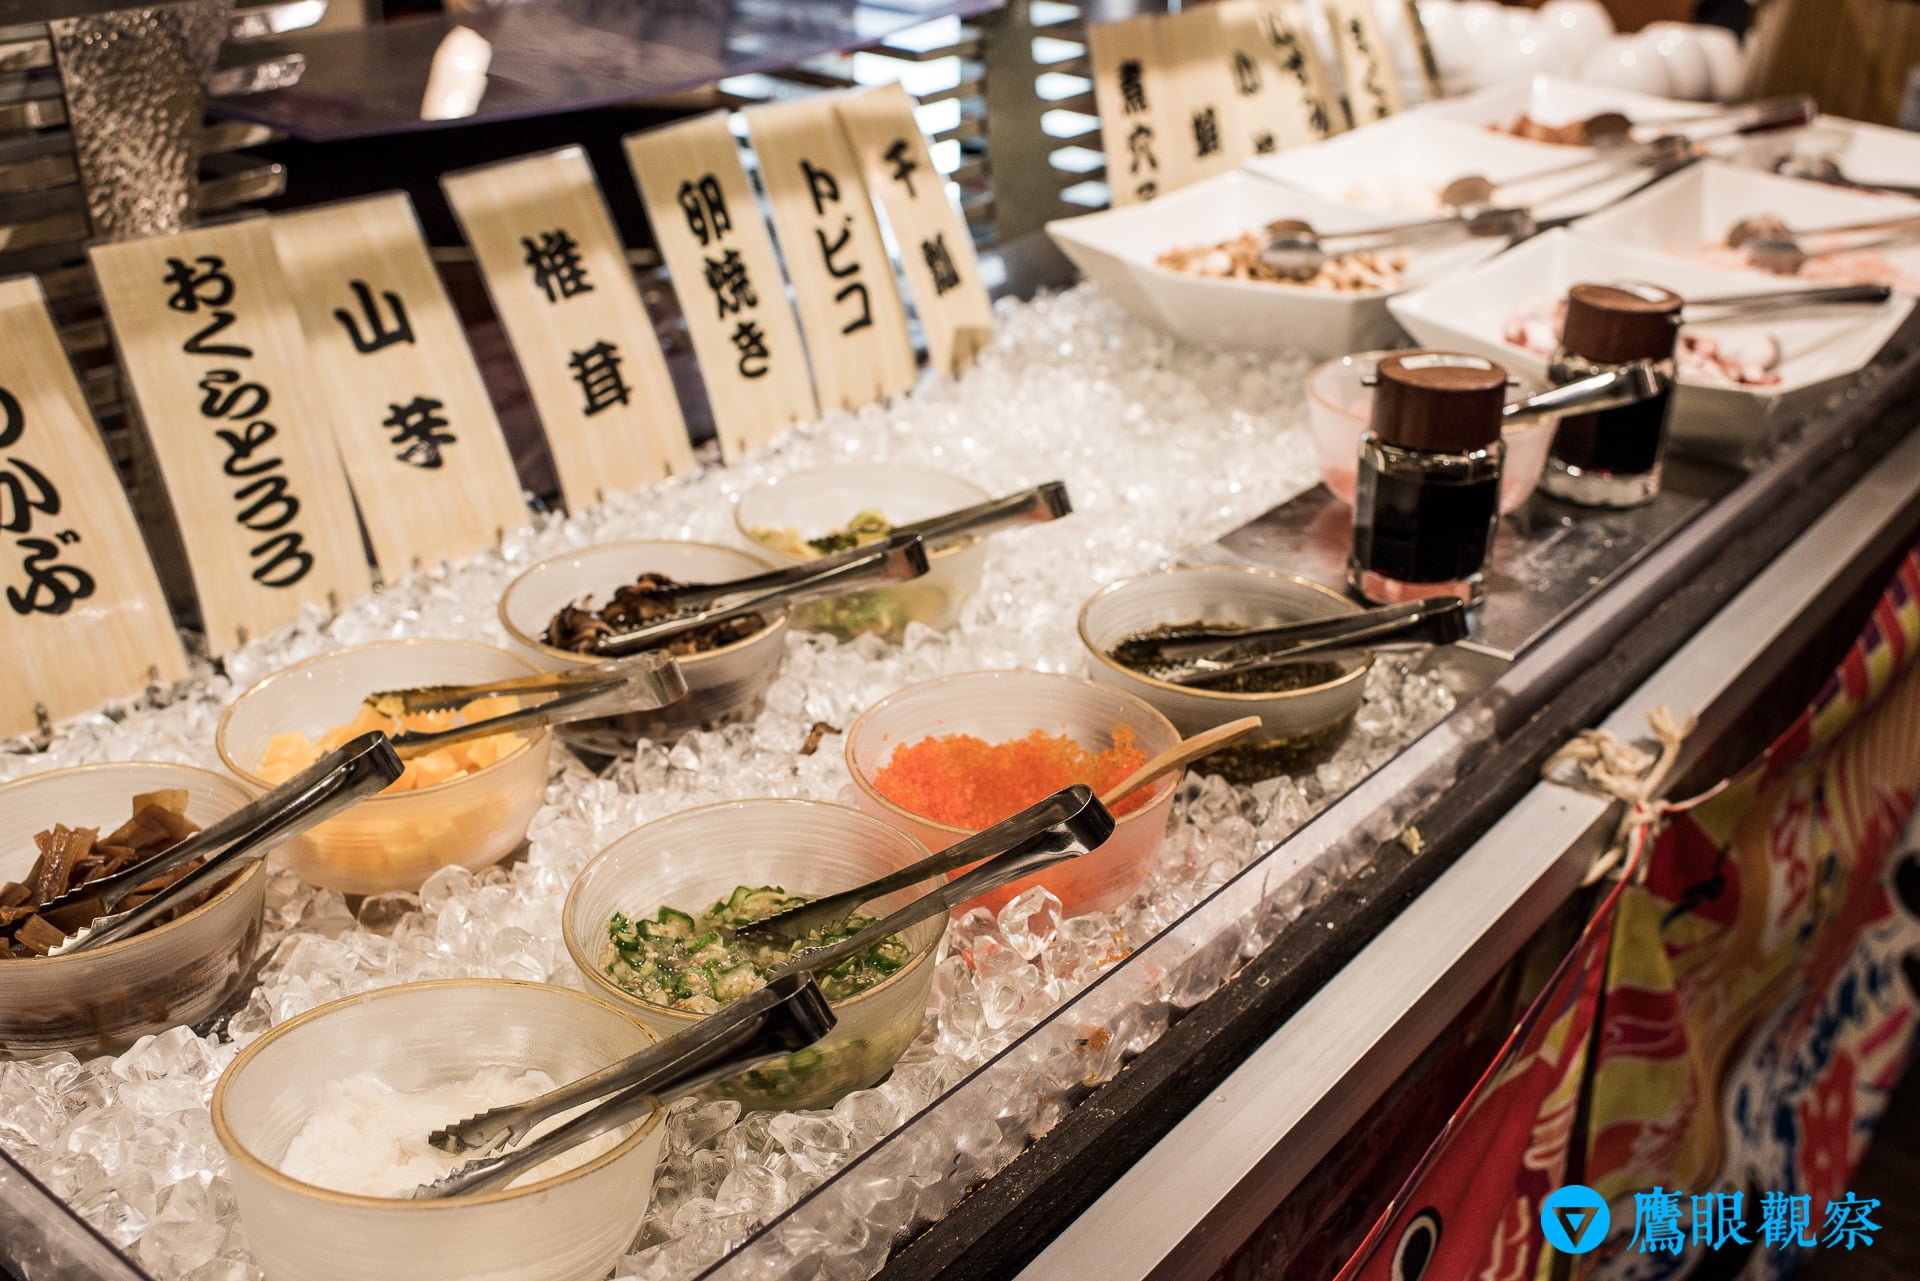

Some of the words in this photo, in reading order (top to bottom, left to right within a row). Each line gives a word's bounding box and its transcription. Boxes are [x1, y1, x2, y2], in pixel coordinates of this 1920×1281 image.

[520, 227, 632, 417] 椎茸
[677, 172, 770, 379] 卵焼き
[162, 255, 314, 588] おくらとろろ
